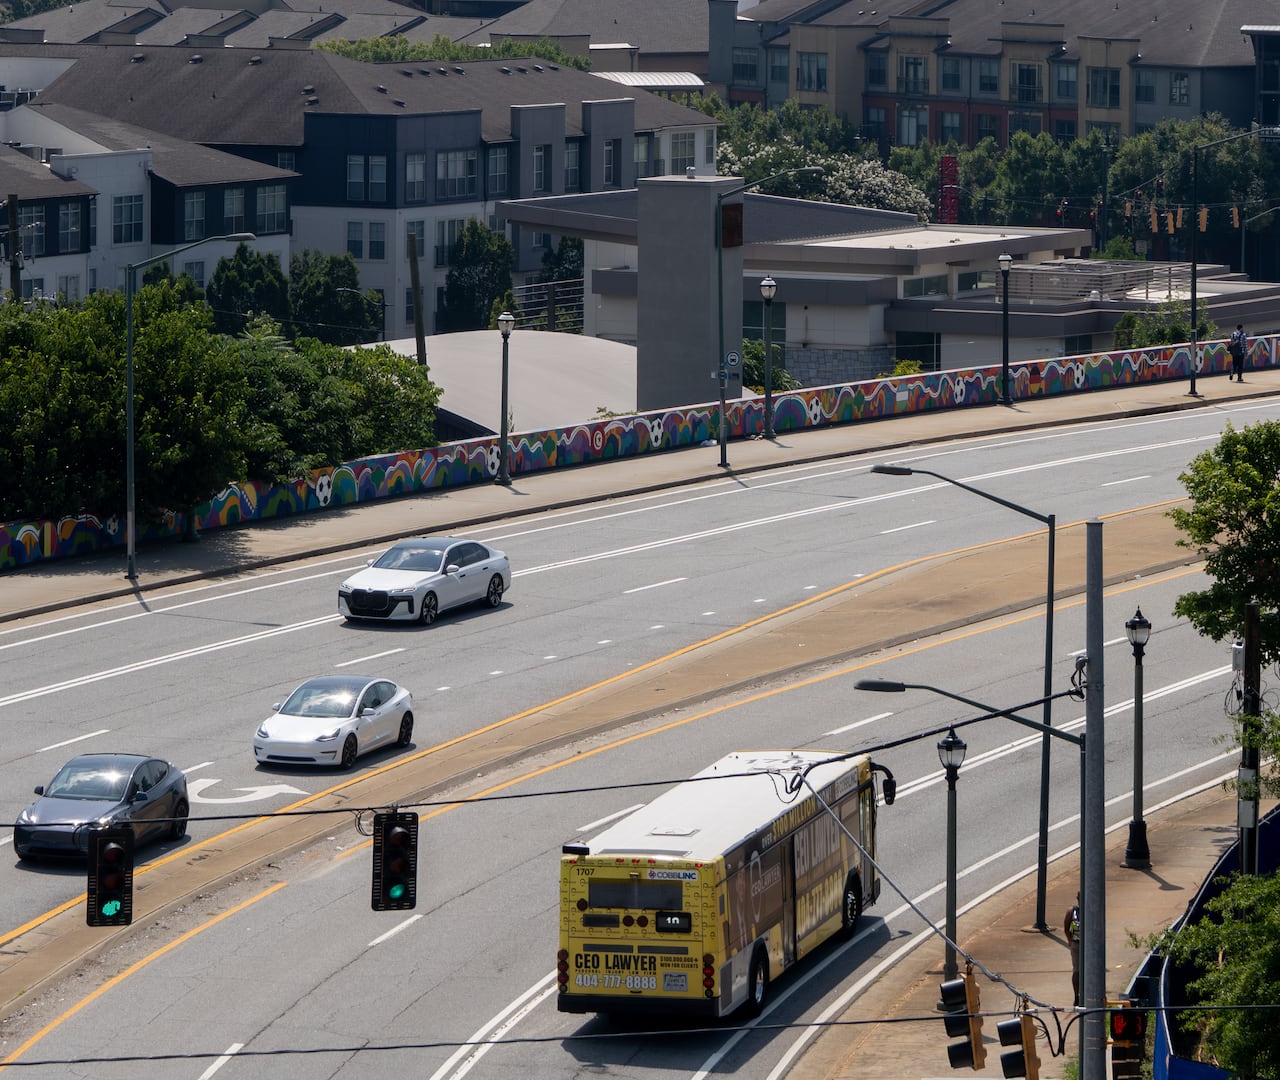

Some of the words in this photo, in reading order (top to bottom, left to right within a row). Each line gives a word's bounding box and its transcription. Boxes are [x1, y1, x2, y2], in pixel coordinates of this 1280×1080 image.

[789, 796, 817, 830] MILLION
[794, 827, 809, 879] CEO
[576, 868, 595, 876] 1707
[575, 954, 600, 969] CEO
[605, 954, 657, 971] LAWYER
[575, 974, 657, 989] 404-777-8888
